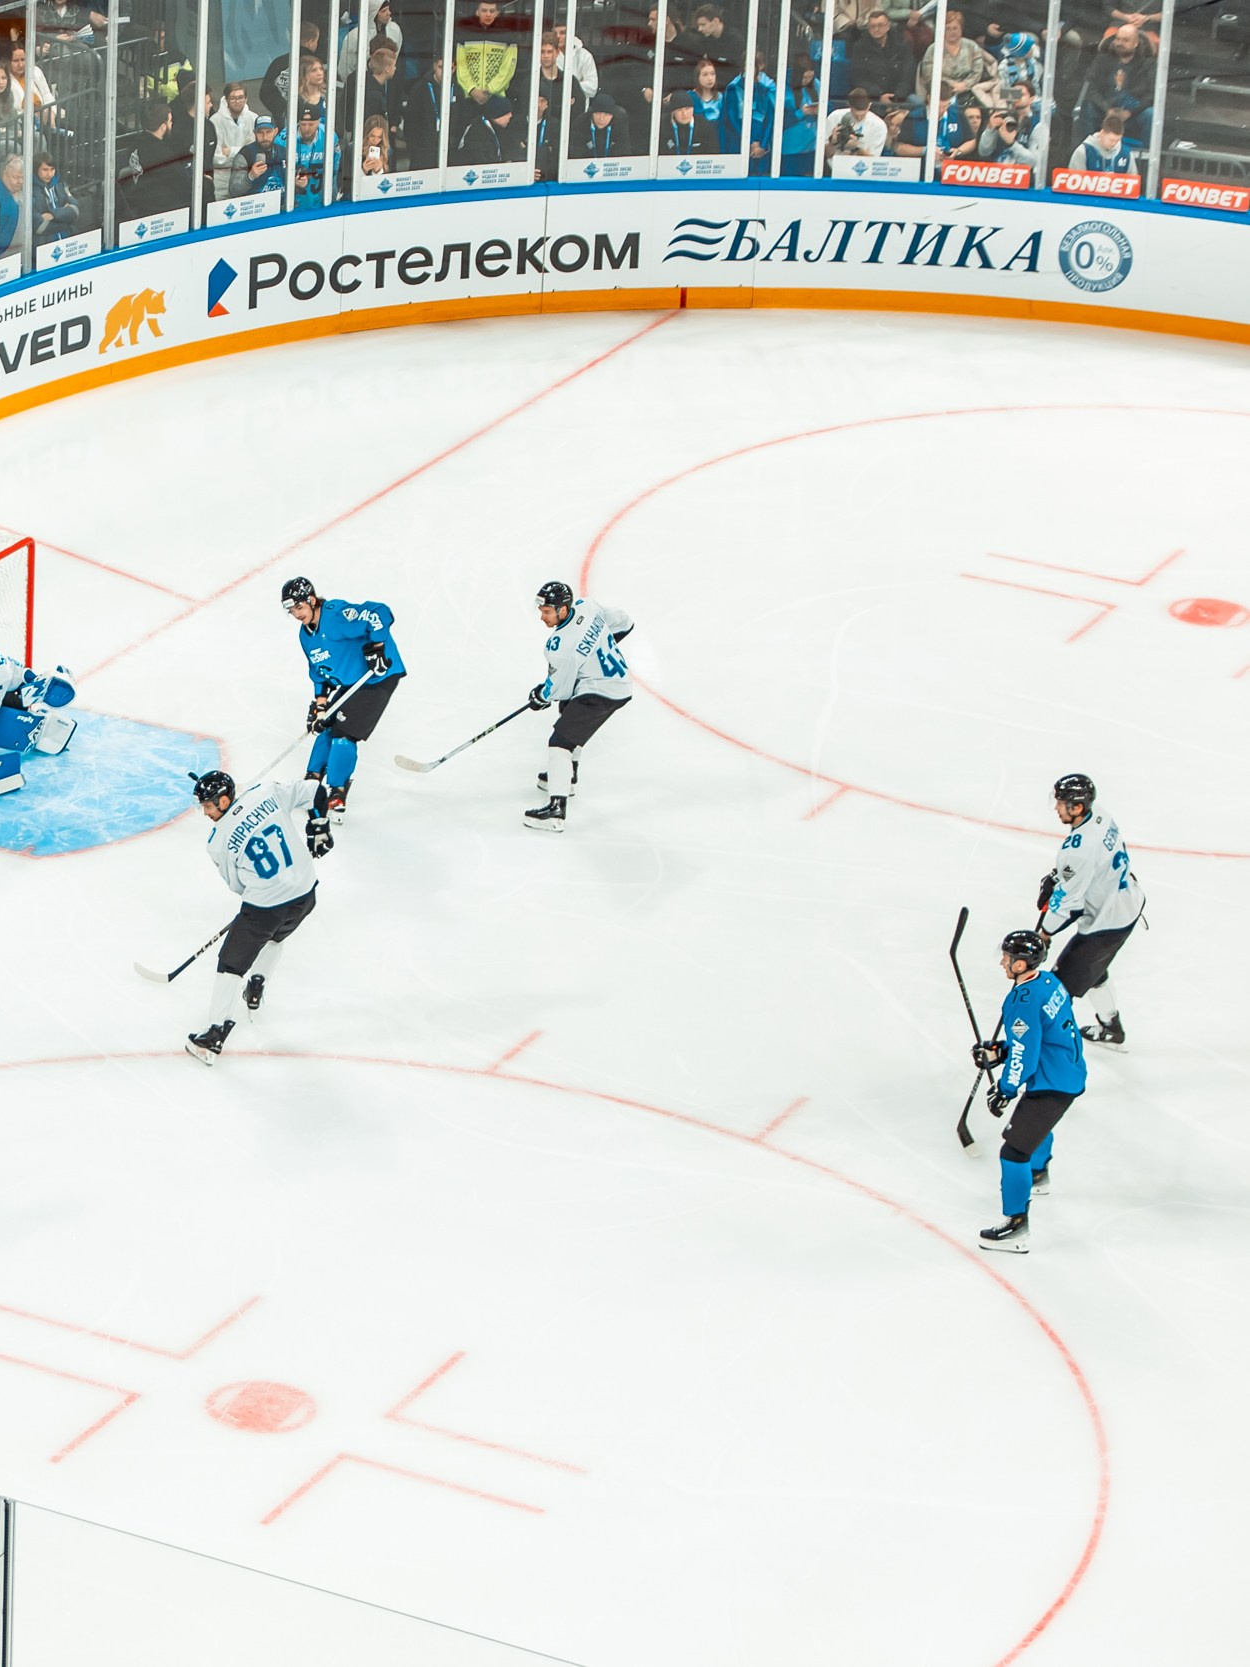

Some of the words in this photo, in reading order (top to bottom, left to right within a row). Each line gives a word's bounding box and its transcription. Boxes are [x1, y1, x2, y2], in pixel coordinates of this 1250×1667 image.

[941, 164, 1029, 186] FONBET
[1052, 173, 1138, 196] FONBET
[1161, 183, 1248, 208] FONBET
[720, 217, 1044, 273] БАЛТИКА
[1060, 222, 1131, 259] БЕЗАЛКОГОЛЬНАЯ
[248, 232, 640, 310] Ростелеком
[1065, 270, 1124, 292] ПРОДУКЦИЯ
[42, 281, 93, 305] ШИНЫ
[227, 796, 280, 854] SHIPACHYOV
[243, 823, 294, 880] 87
[1062, 834, 1082, 849] 28
